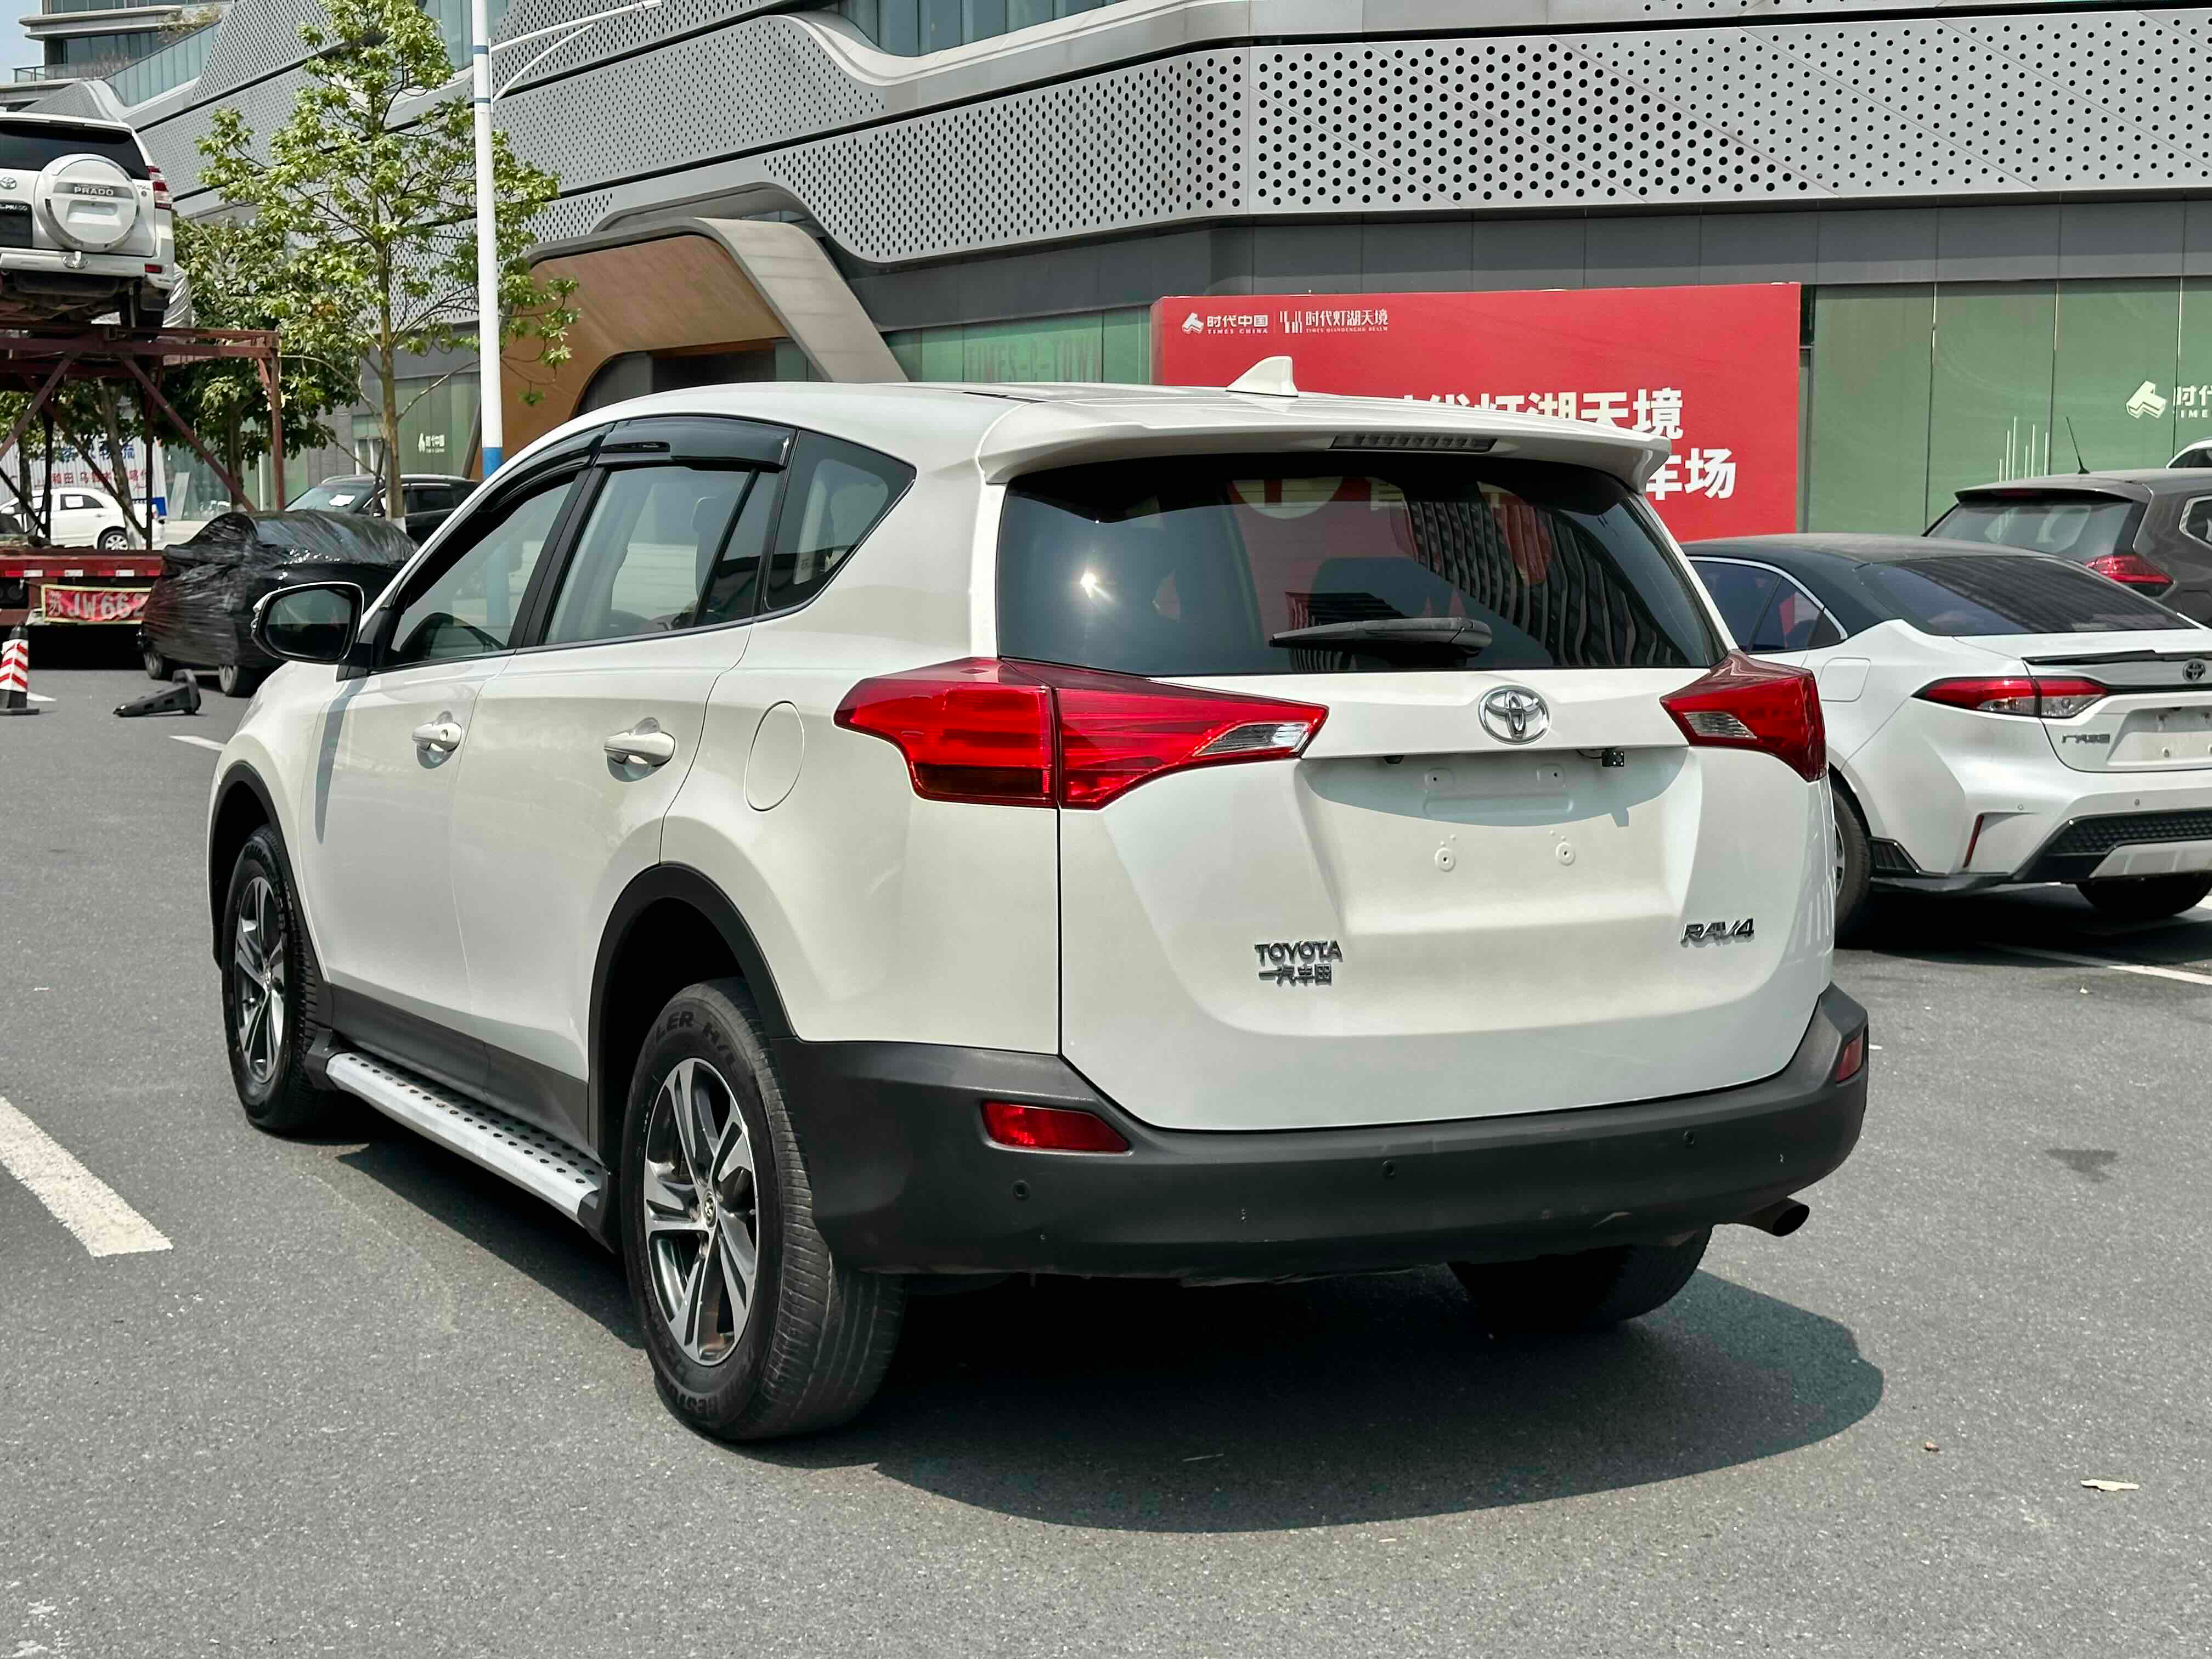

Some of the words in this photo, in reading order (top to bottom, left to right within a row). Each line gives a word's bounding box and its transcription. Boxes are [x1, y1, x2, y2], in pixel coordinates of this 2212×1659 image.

[74, 186, 114, 196] PRADO
[1207, 315, 1268, 328] 时代中国
[1306, 308, 1389, 326] 时代灯湖天境
[1680, 918, 1755, 945] RAV4
[1254, 939, 1343, 966] TOYOTA
